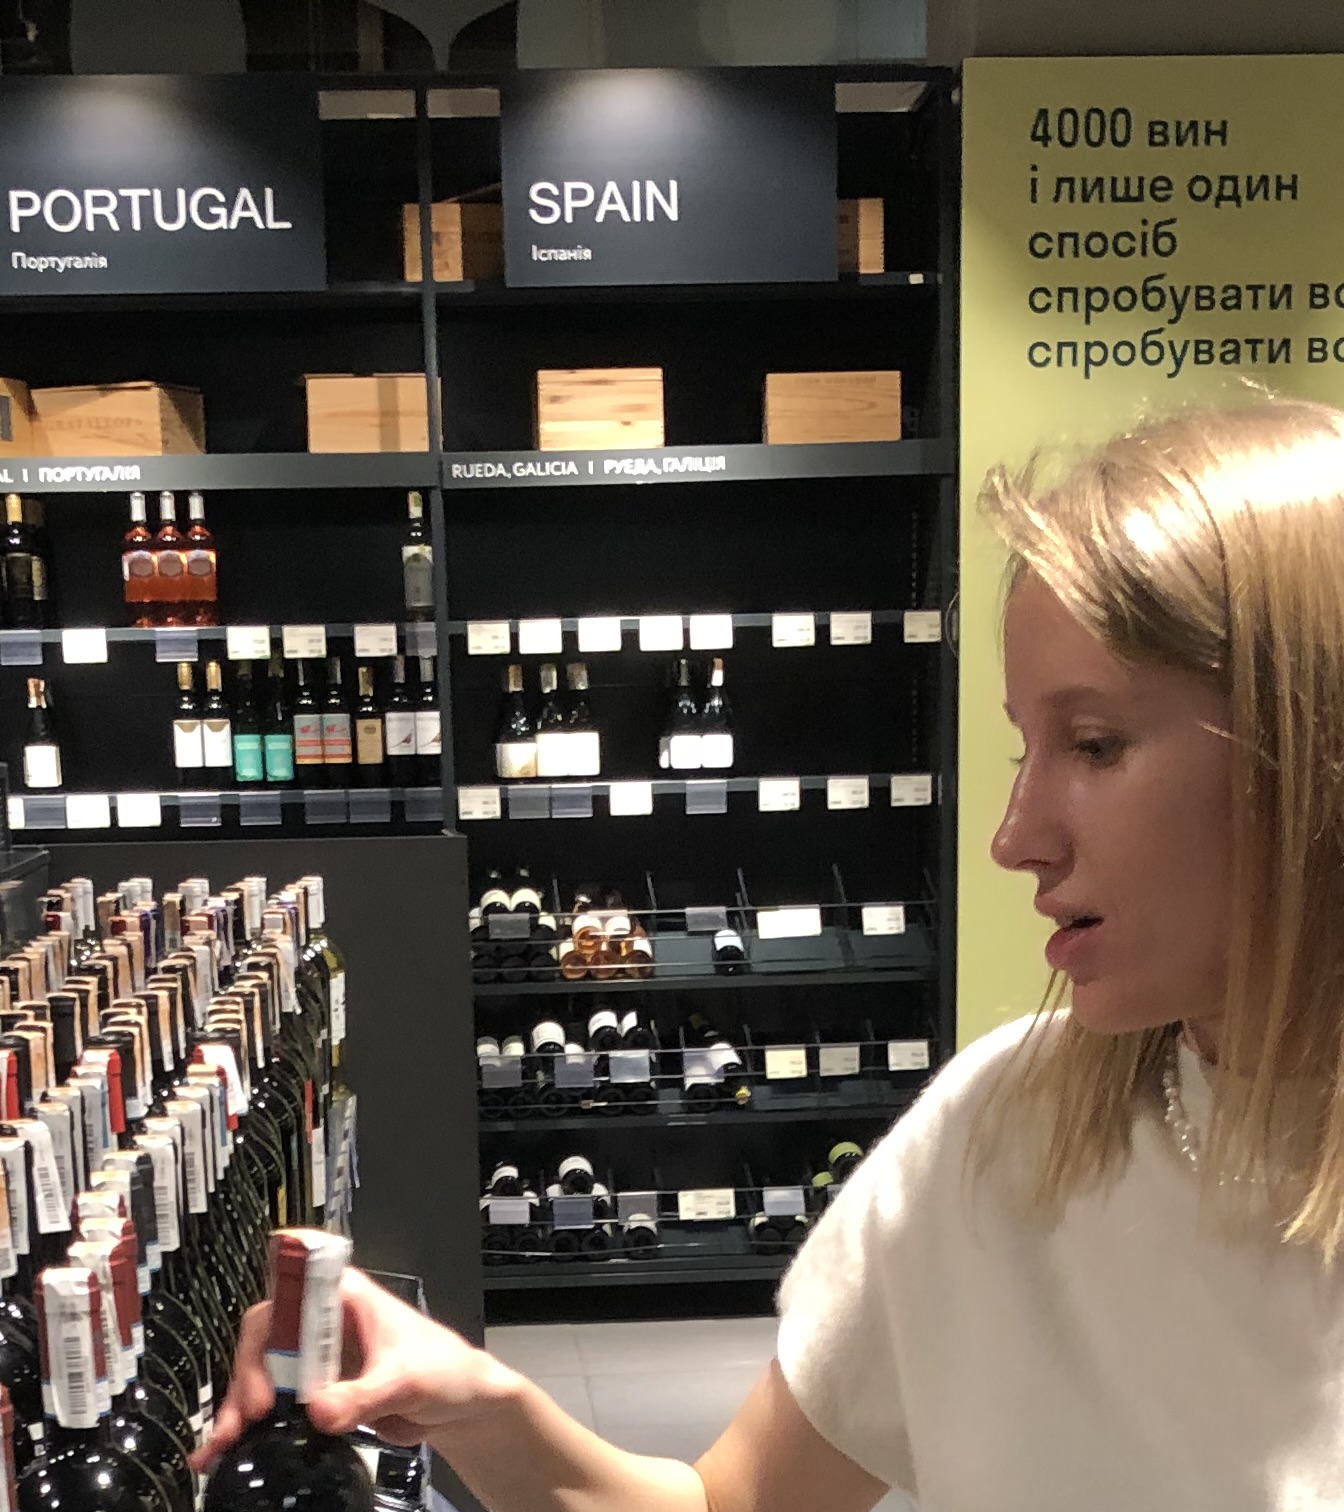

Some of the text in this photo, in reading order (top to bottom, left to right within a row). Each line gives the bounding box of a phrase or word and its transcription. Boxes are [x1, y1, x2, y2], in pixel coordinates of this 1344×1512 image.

[1031, 108, 1227, 148] 4000 вин
[529, 180, 678, 224] SPAIN
[1031, 165, 1297, 208] і лише один
[9, 188, 291, 232] PORTUGAL
[532, 245, 591, 261] Іспанія
[1029, 218, 1177, 259] спосіб
[12, 252, 107, 272] Португалія
[1029, 273, 1292, 324] спробувати
[1029, 327, 1291, 379] спробувати
[39, 465, 140, 482] ПОРТУГАЛІЯ
